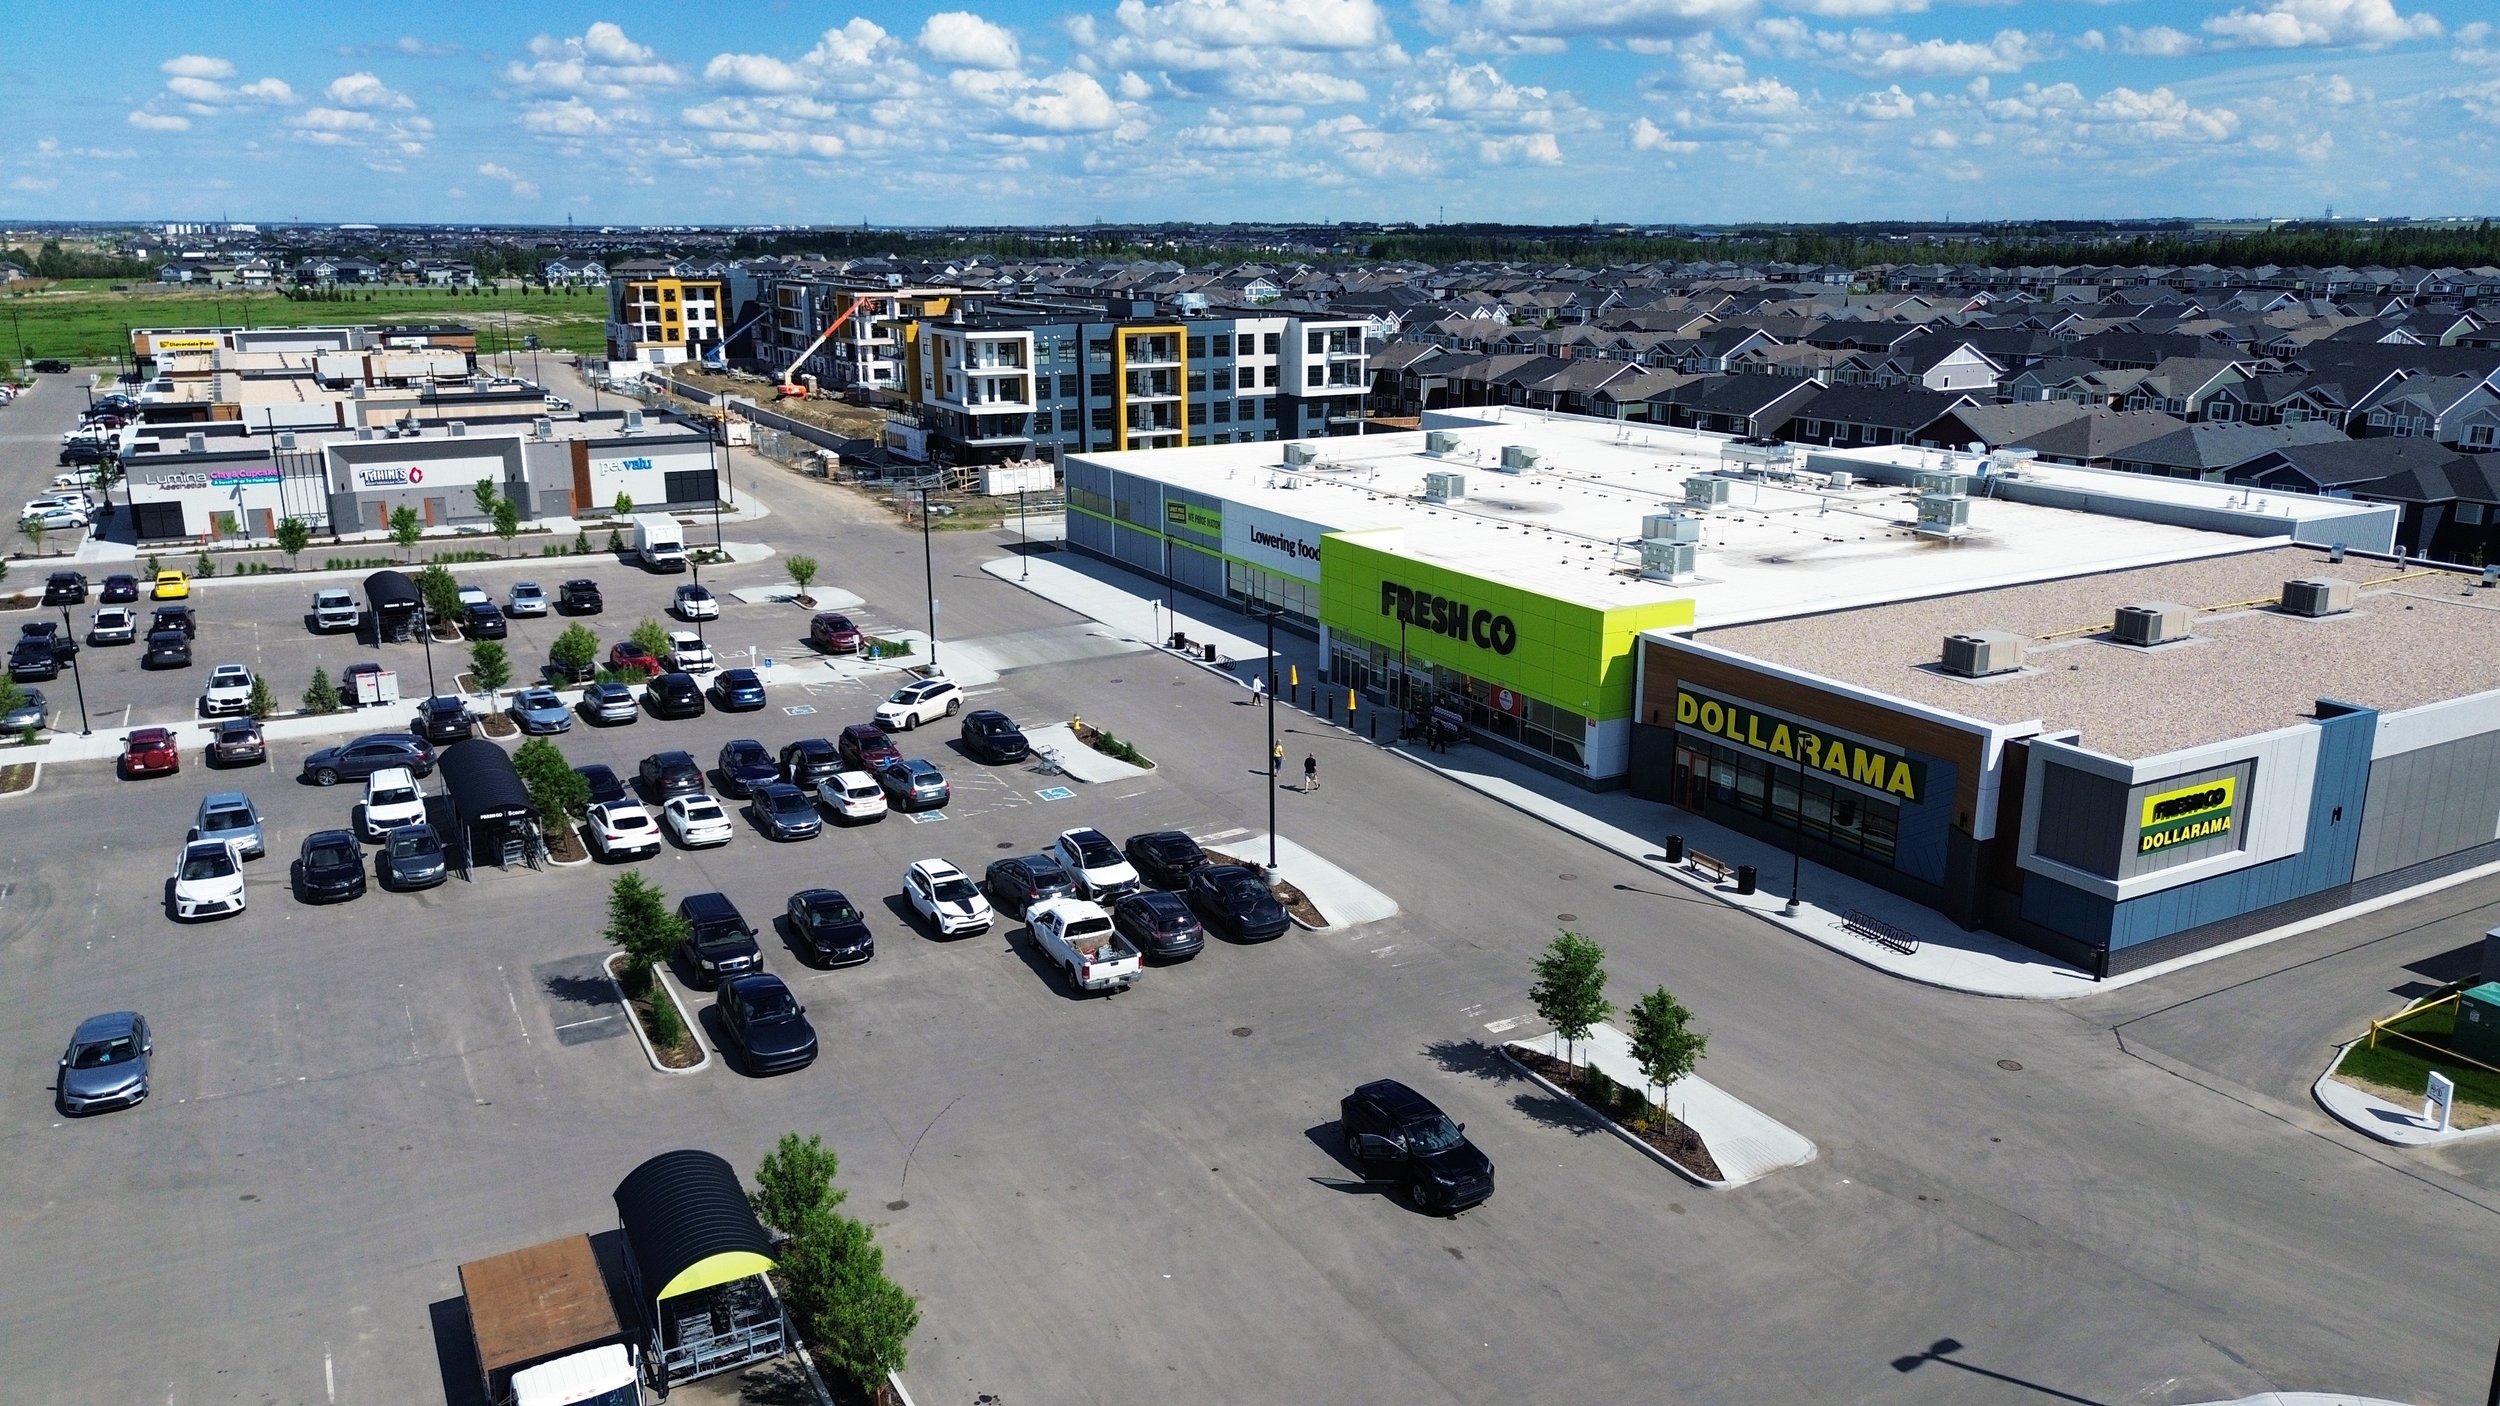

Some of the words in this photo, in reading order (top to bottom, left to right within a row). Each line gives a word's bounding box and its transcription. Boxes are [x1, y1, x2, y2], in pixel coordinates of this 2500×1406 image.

[145, 471, 207, 485] Lumina
[210, 471, 231, 479] Clay
[359, 468, 407, 482] TAHINI'S
[1250, 525, 1296, 557] Lowering
[1298, 538, 1320, 562] food
[1676, 691, 1915, 800] DOLLARAMA
[2141, 816, 2231, 851] DOLLARAMA
